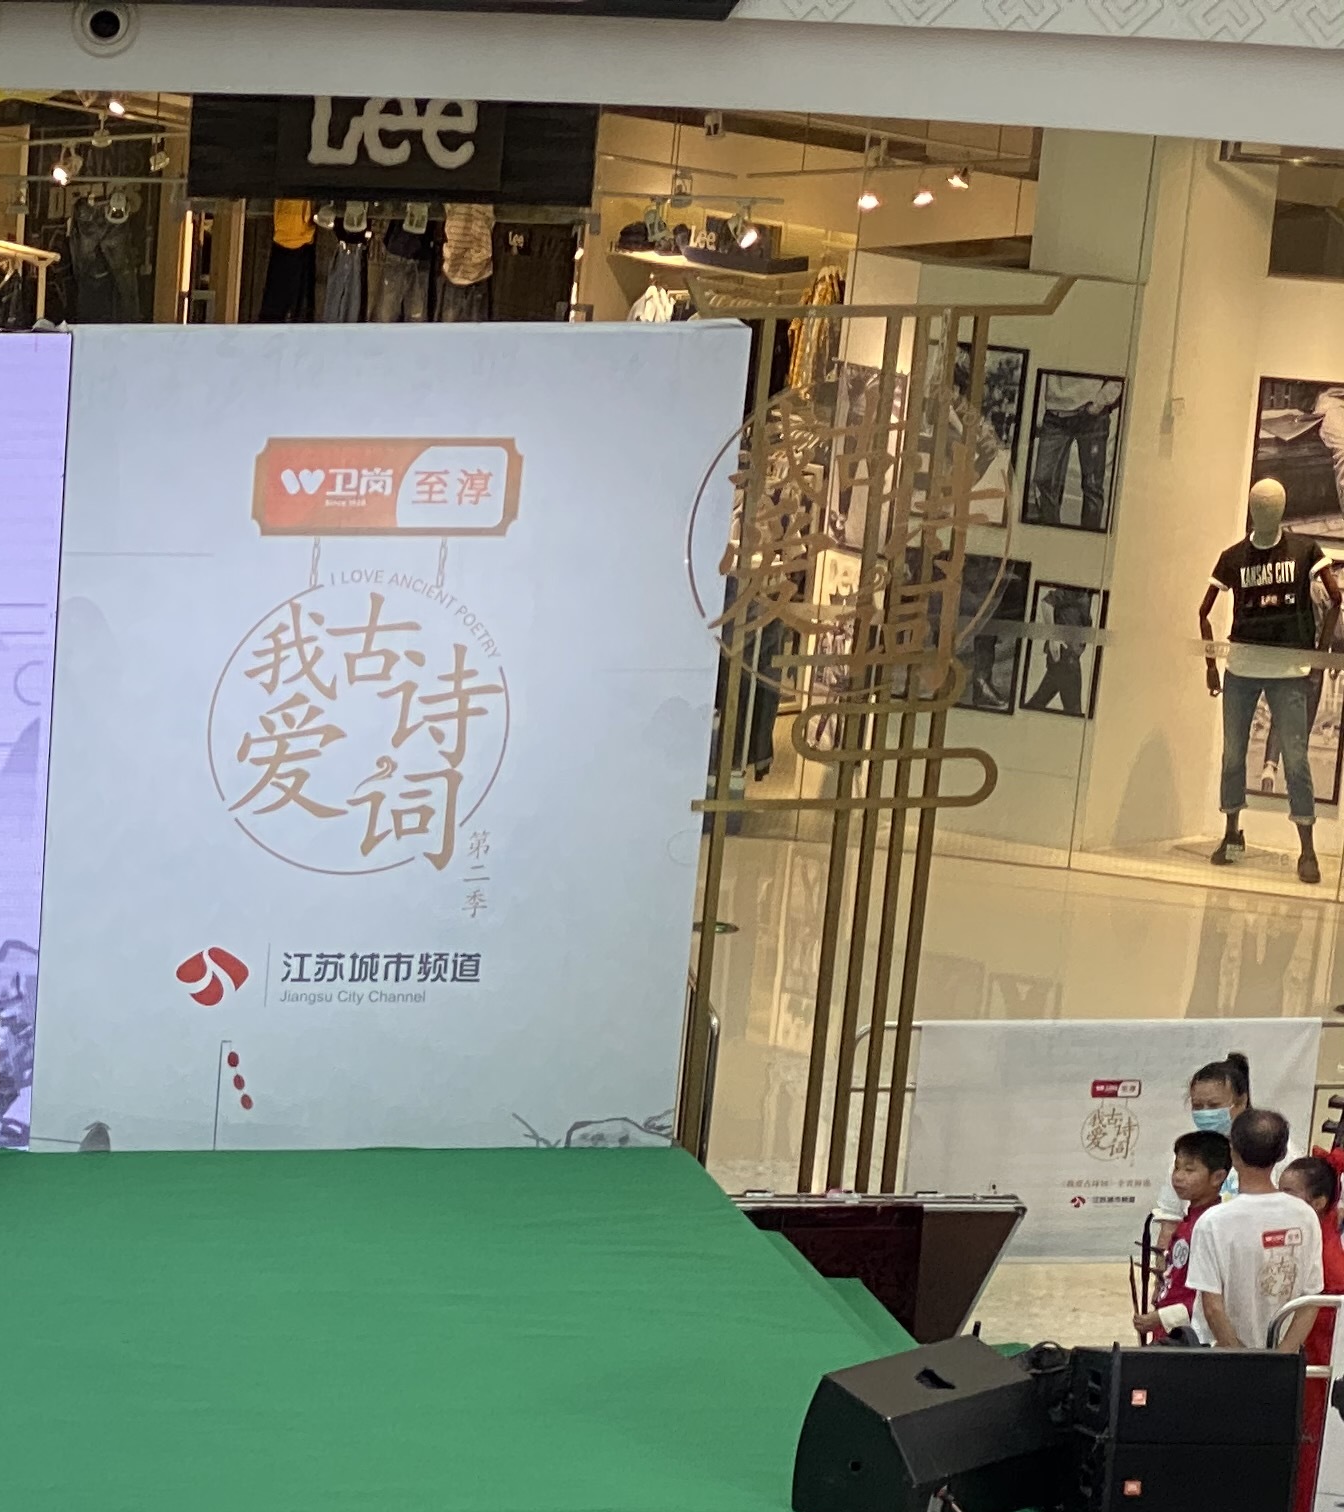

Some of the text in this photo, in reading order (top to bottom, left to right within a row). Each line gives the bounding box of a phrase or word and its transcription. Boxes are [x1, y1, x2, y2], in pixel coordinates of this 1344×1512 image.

[307, 95, 479, 170] Lee
[689, 225, 716, 251] Lee
[325, 467, 494, 506] 卫岗 至淳
[1240, 560, 1296, 588] KANSAS CITY
[341, 569, 385, 584] LOVE
[387, 573, 459, 610] ANCIENT
[454, 604, 504, 660] POETRY
[462, 830, 492, 918] 第二季
[281, 952, 482, 983] 江苏城市频道
[280, 989, 426, 1006] Jiangsu City Channel
